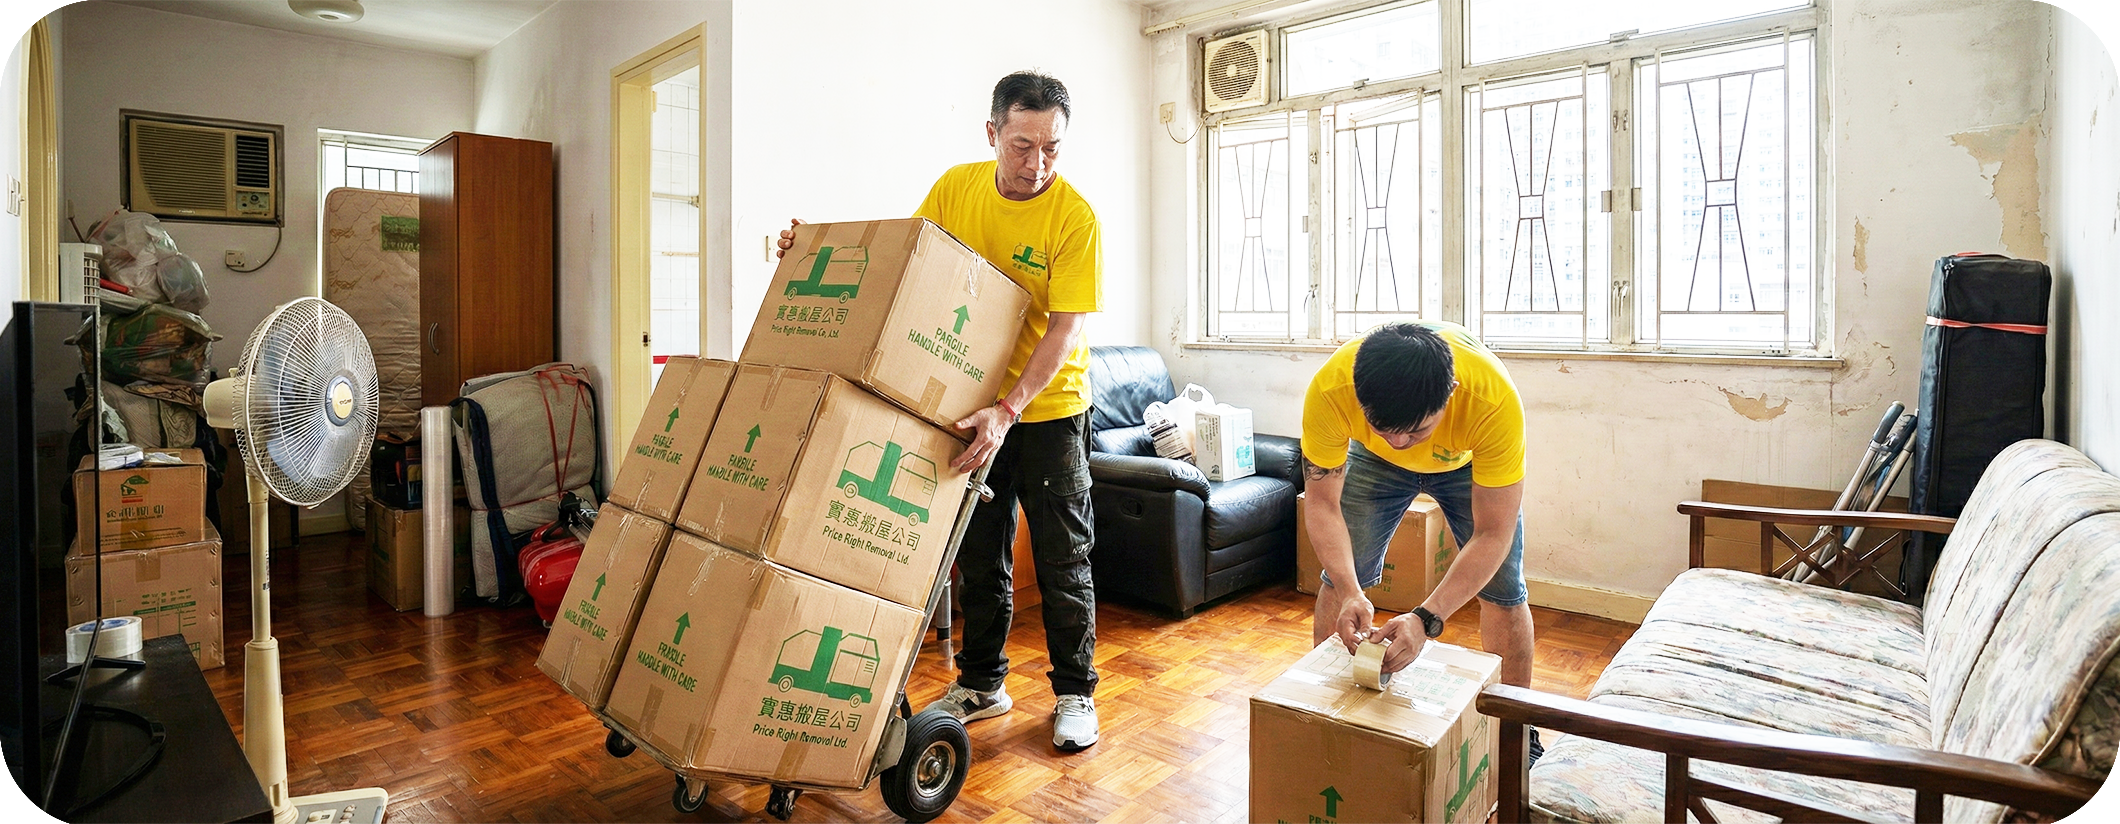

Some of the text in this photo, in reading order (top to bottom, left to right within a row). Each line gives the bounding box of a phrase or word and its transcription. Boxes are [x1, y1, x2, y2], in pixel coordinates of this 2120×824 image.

[908, 328, 985, 383] HANDLE WITH CARE
[666, 451, 683, 465] CARE
[706, 465, 769, 491] HANDLE WITH CARE
[822, 525, 843, 542] Price
[844, 533, 865, 549] Right
[865, 541, 896, 560] Removal
[825, 500, 921, 551] 實惠搬屋公司
[636, 650, 698, 693] HANDLE WITH CARE
[758, 696, 862, 732] 實惠搬屋公司
[753, 723, 848, 748] Price Right Removal Ltd.
